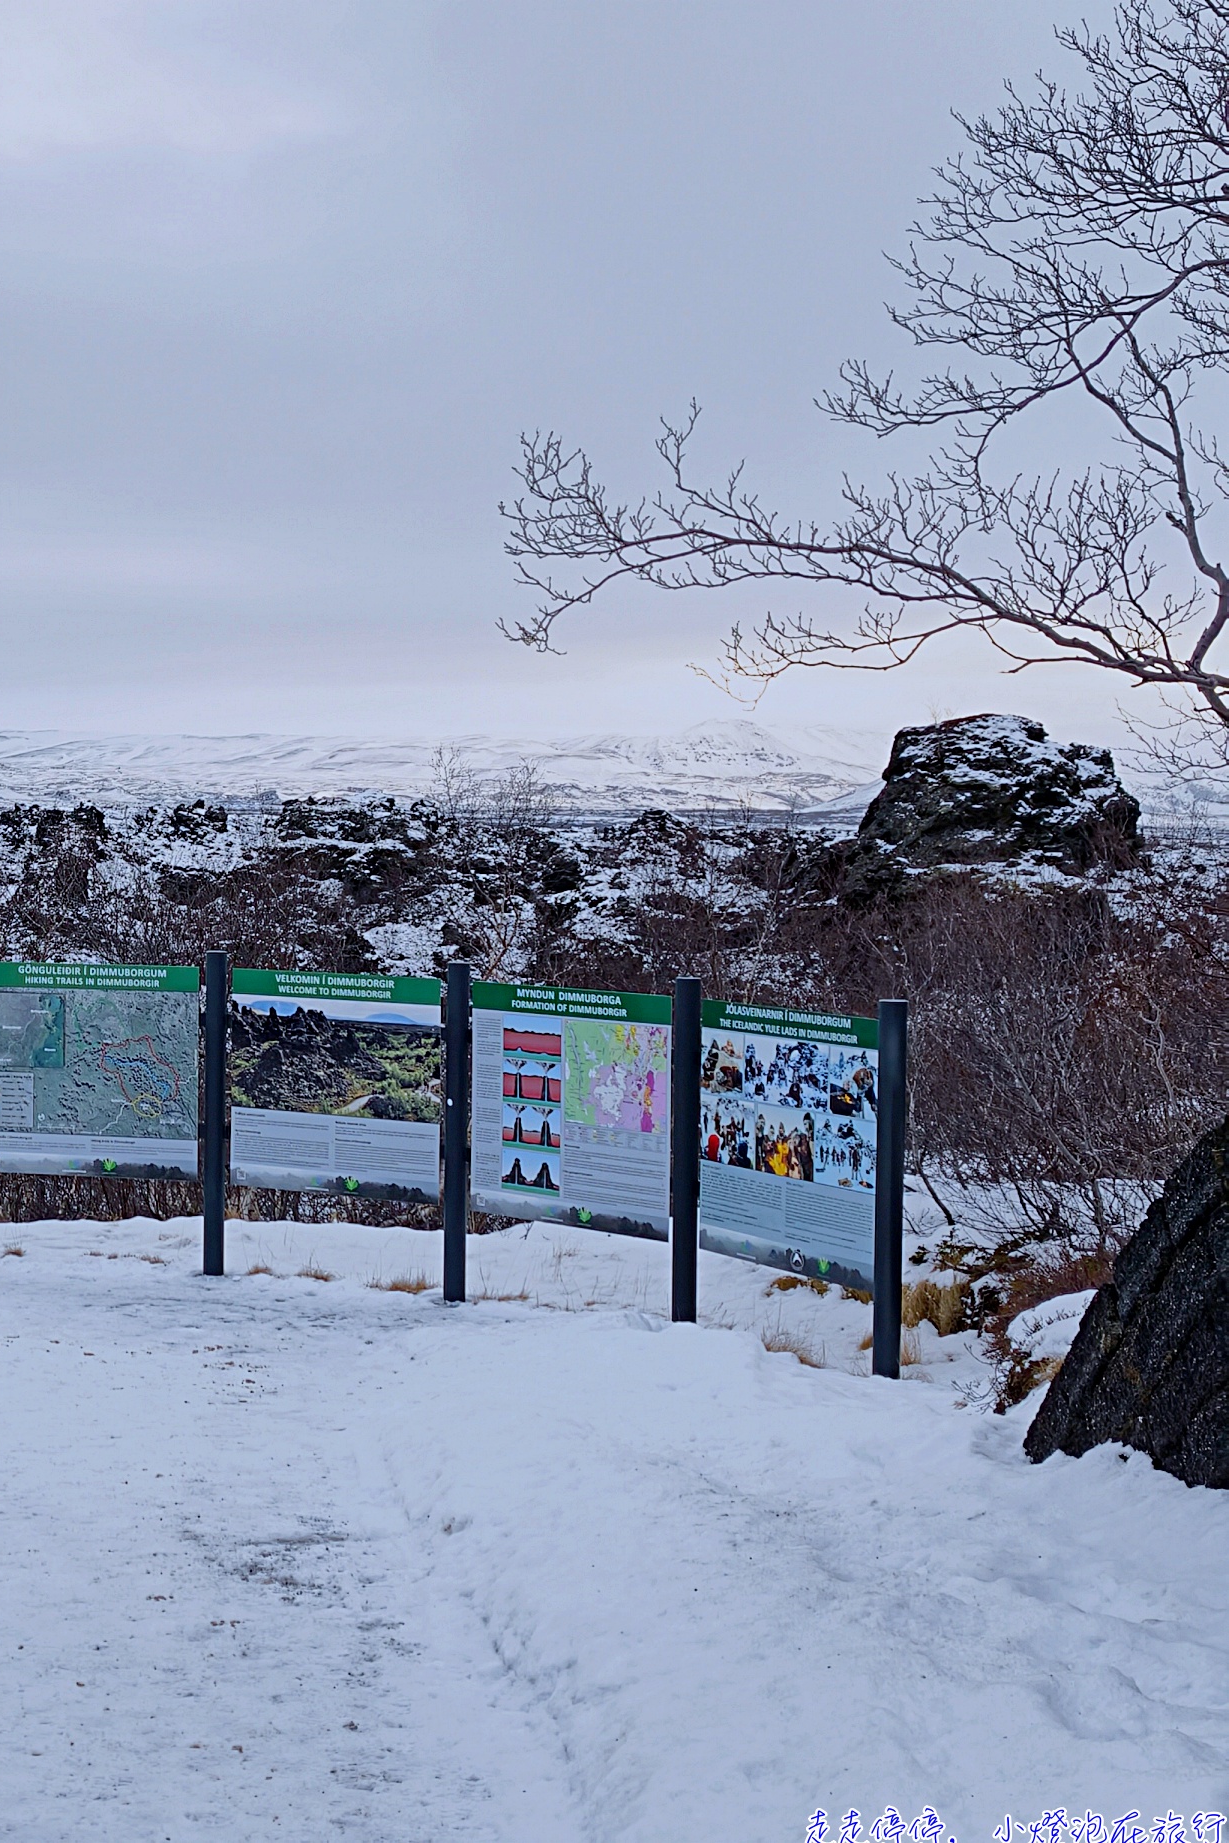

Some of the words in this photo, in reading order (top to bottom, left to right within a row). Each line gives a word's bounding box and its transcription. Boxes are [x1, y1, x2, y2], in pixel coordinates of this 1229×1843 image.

[90, 968, 167, 978] DIMMUBORGUM
[275, 973, 320, 985] VELKOMIN
[327, 976, 395, 989] DIMMUBORGIR
[25, 976, 53, 984] HIKING
[56, 977, 83, 985] TRAILS
[85, 977, 94, 986] IN
[97, 978, 160, 988] DIMMUBORGIR
[278, 985, 317, 995] WELCOME
[319, 987, 329, 996] TO
[331, 988, 392, 999] DIMMUBORGIR
[517, 989, 555, 1000] MYNDUN
[558, 992, 622, 1005] DIMMUBORGA
[511, 999, 555, 1011] FORMATION
[556, 1003, 568, 1012] OF
[569, 1004, 627, 1017] DIMMUBORGIR
[725, 1003, 784, 1021] JÓLASVEINARNIR
[789, 1012, 851, 1029] DIMMUBORGUM
[720, 1018, 732, 1028] THE
[732, 1019, 764, 1033] ICELANDIC
[765, 1024, 781, 1035] YULE
[781, 1026, 798, 1037] LADS
[798, 1029, 806, 1038] IN
[807, 1029, 858, 1044] DIMMUBORGIR
